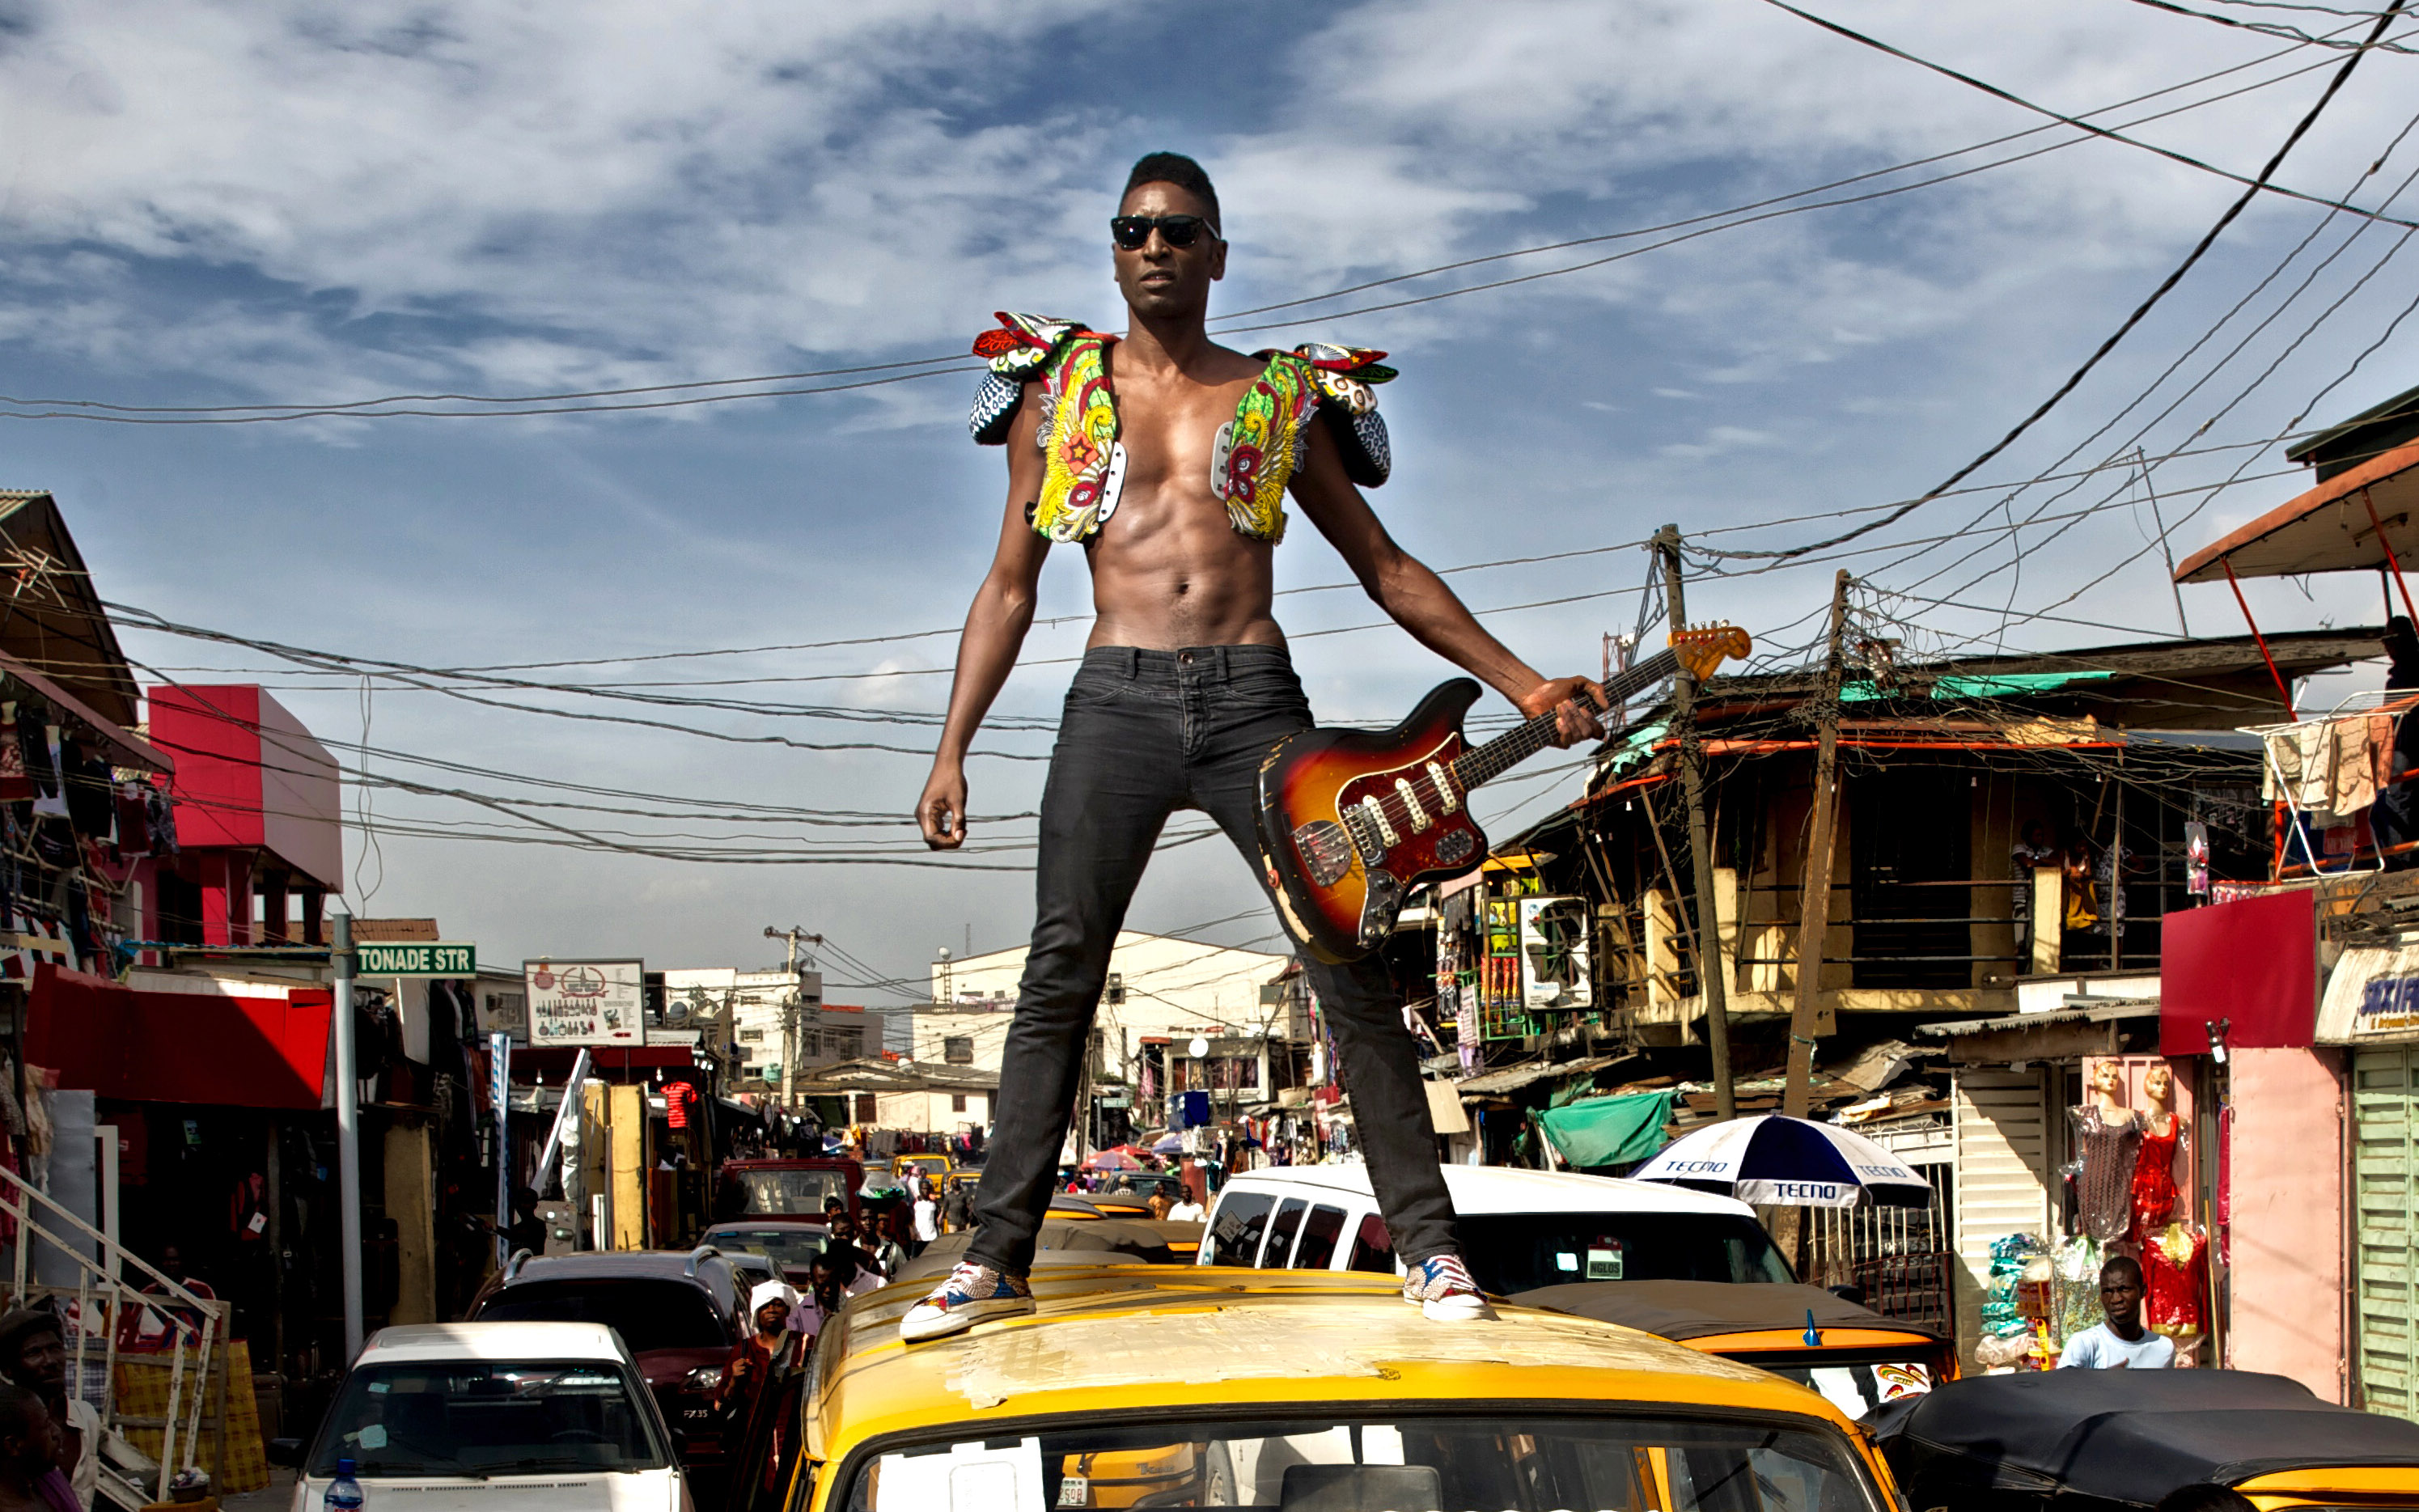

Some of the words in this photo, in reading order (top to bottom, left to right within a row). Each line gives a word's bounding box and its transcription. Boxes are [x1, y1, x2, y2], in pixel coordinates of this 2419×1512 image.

[358, 949, 430, 971] TONADE
[434, 949, 469, 971] STR
[1666, 1161, 1728, 1173] TECNO
[1857, 1165, 1908, 1178] TECNO
[1773, 1183, 1836, 1199] TECNO
